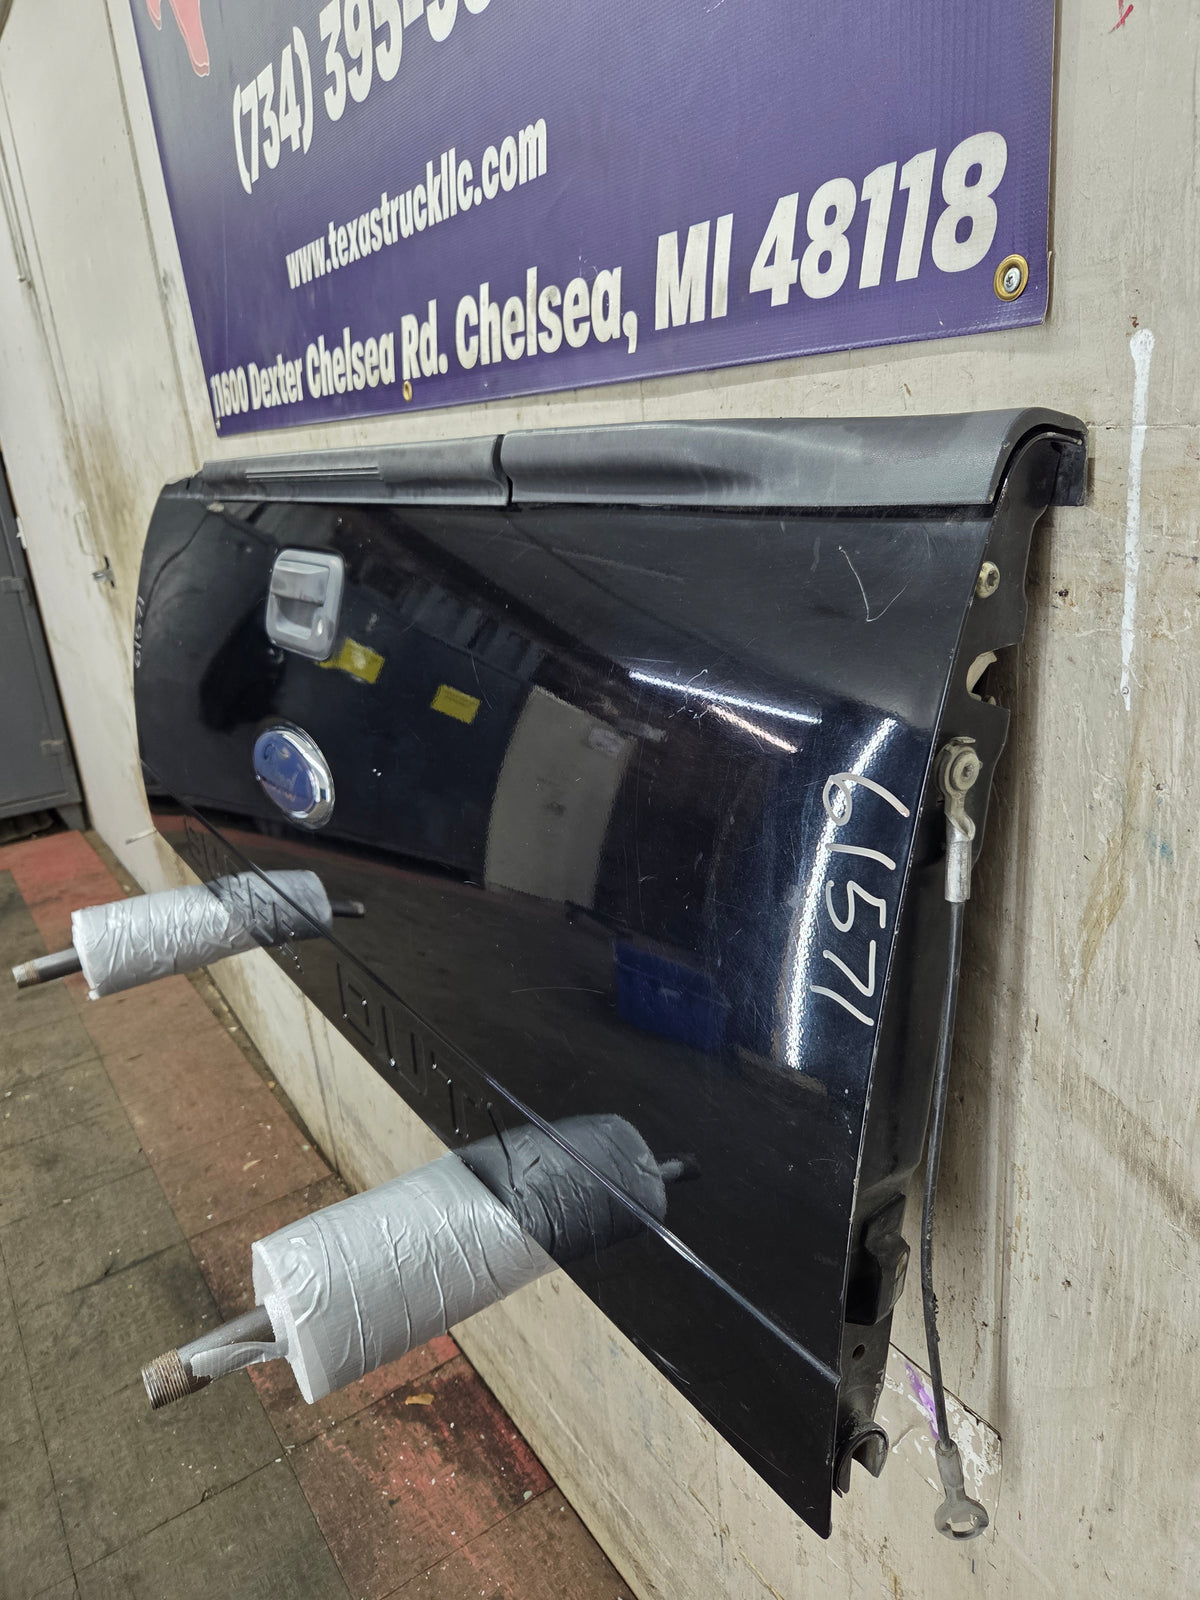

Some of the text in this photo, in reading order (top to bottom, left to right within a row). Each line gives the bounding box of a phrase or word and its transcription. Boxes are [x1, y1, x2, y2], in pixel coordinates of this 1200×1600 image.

[232, 0, 490, 195] (734) 395-
[285, 117, 549, 290] www.texastruckllc.com
[210, 130, 1008, 419] 11600 Dexter Chelsea Rd. Chelsea, MI 48118
[809, 771, 911, 1027] 61571
